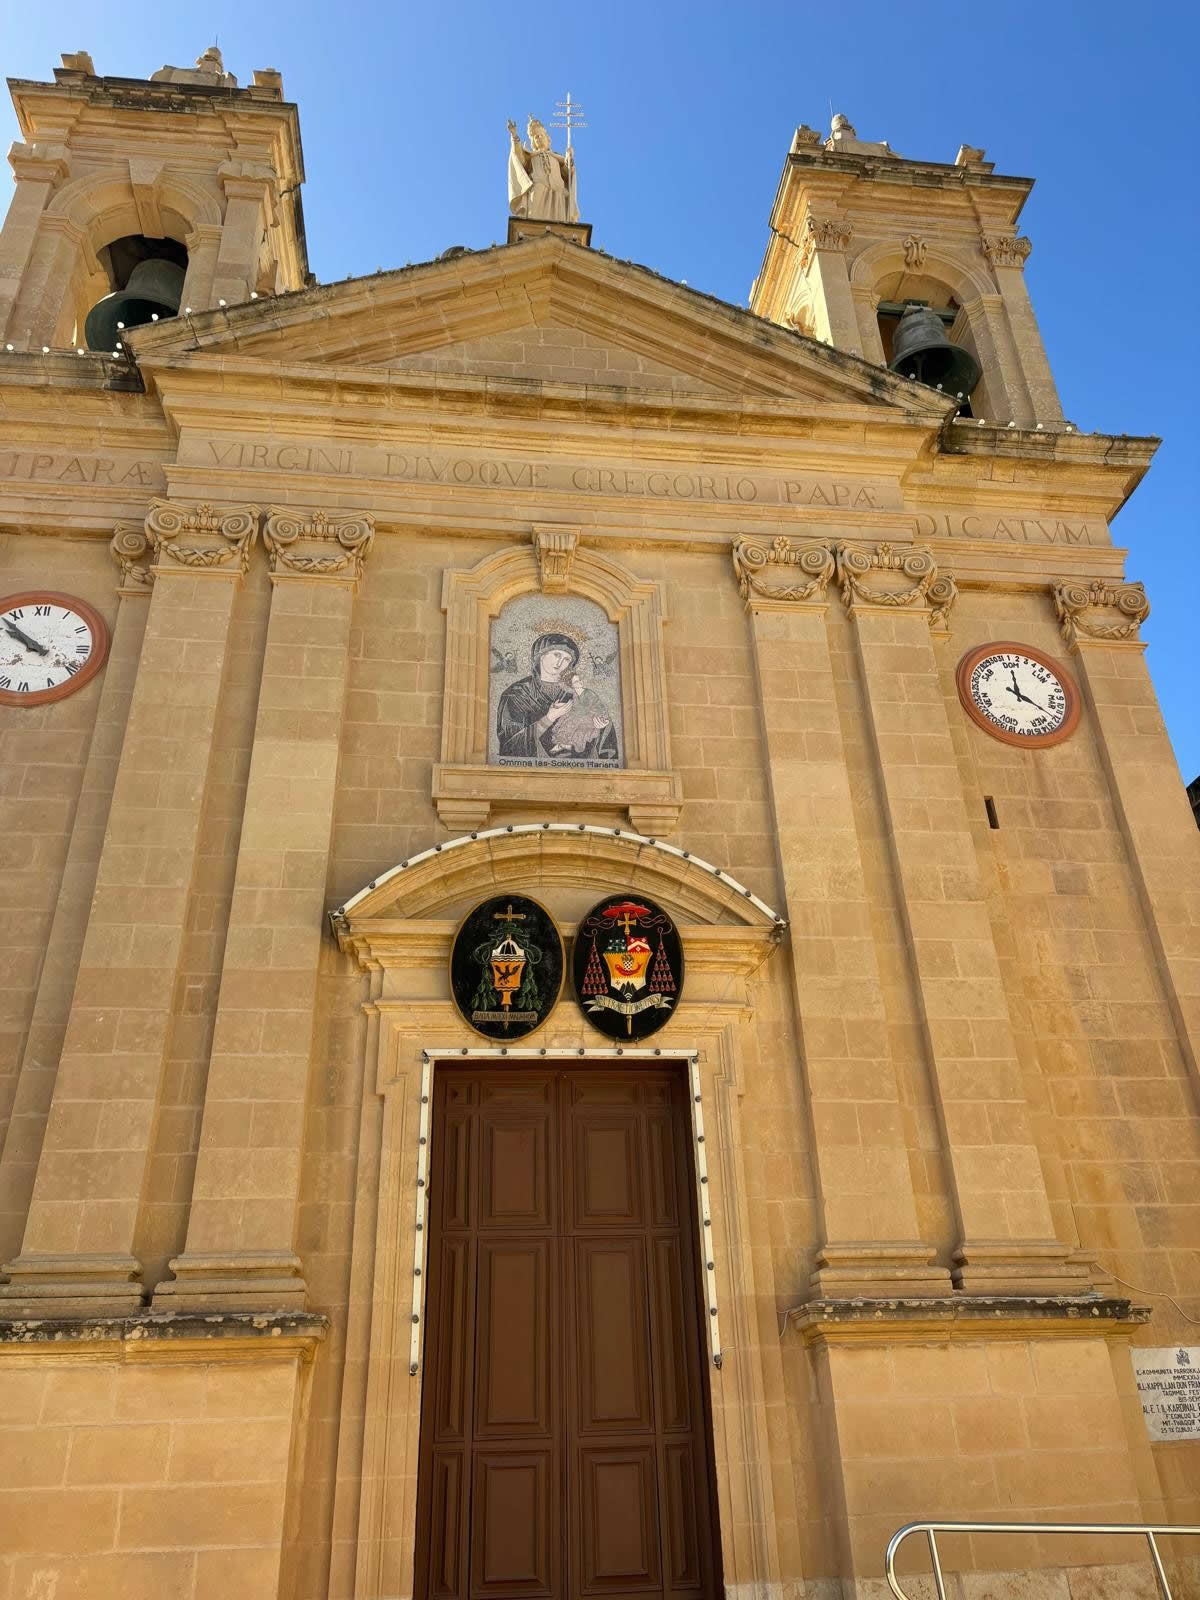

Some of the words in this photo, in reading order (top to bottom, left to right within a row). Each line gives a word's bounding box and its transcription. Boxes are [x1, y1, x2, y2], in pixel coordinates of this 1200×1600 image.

[207, 441, 353, 474] VIRGINI
[384, 453, 550, 489] DIVOQVE
[571, 467, 758, 501] GREGORIO
[914, 512, 1092, 545] DICATVM
[8, 609, 24, 621] XI
[34, 606, 51, 616] XII
[74, 625, 88, 634] II
[75, 645, 91, 654] III
[981, 669, 994, 682] SAB
[1032, 670, 1048, 684] LUN
[17, 681, 29, 691] VI
[47, 677, 55, 687] V
[981, 692, 993, 708] VEN
[1047, 694, 1056, 710] MAR
[1000, 714, 1018, 726] GIOV
[1030, 715, 1047, 727] MER
